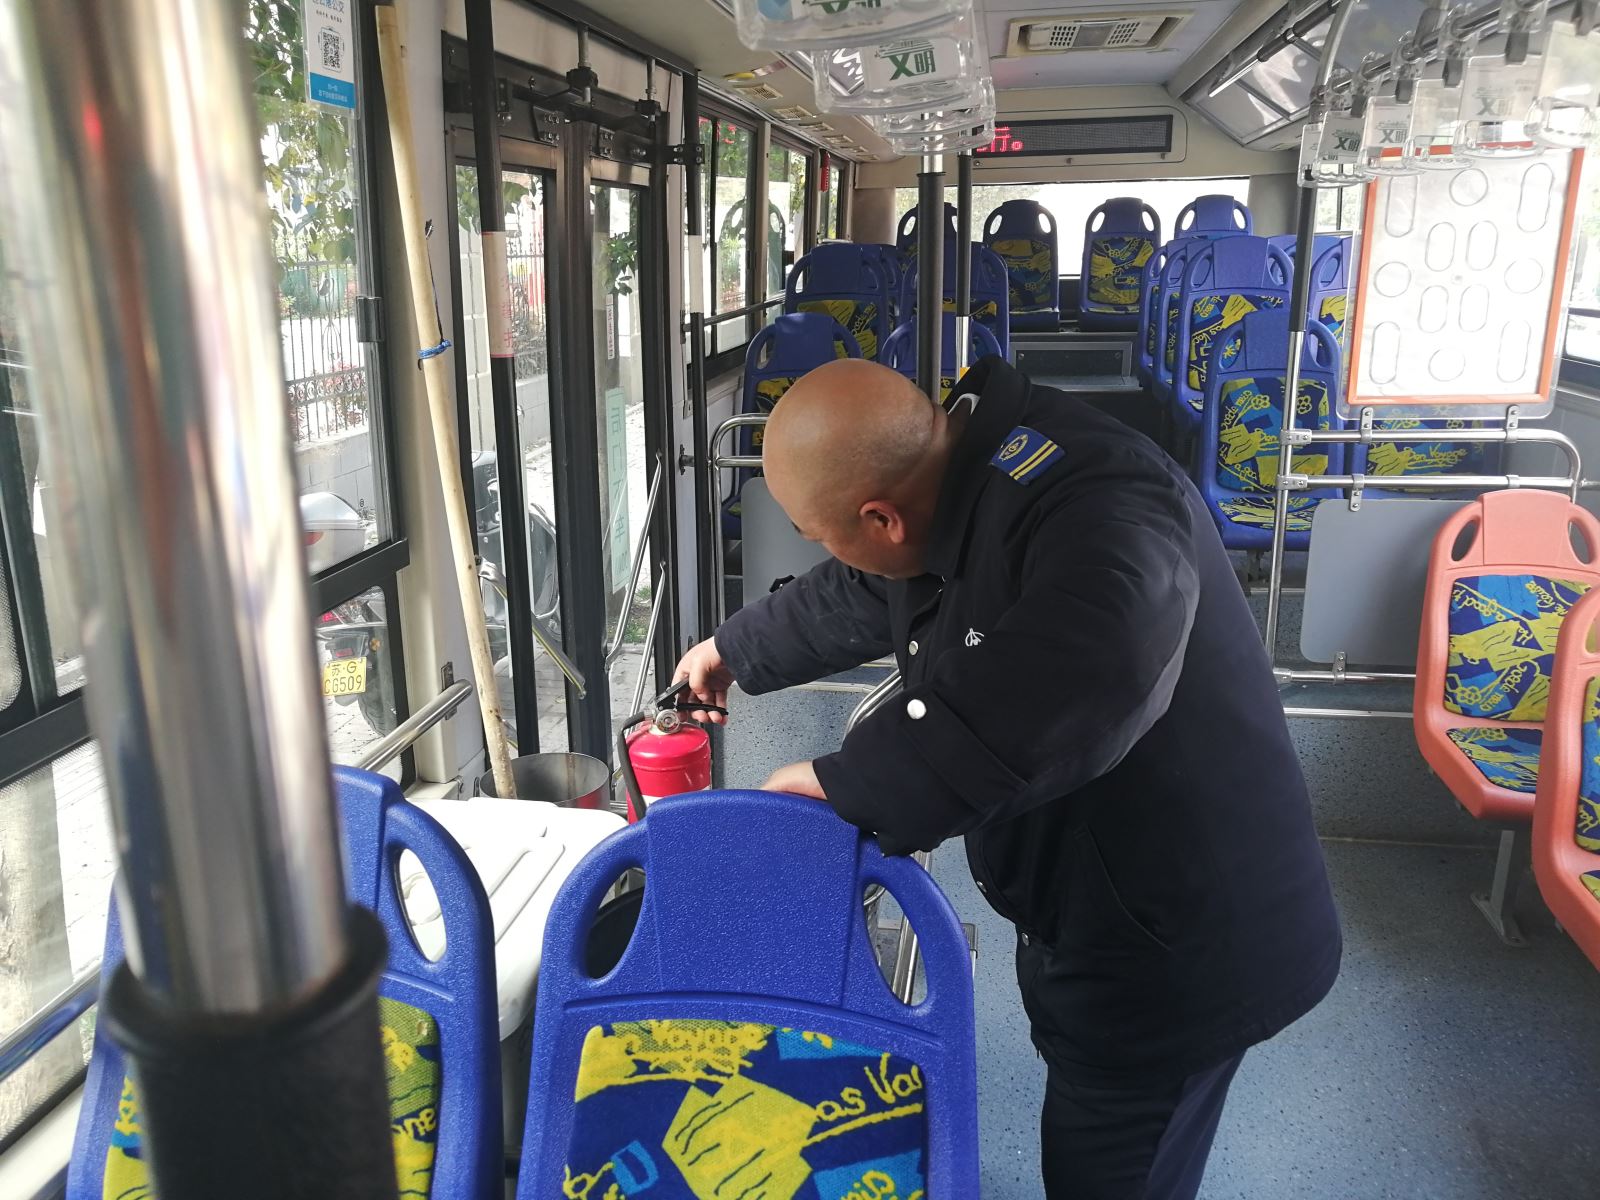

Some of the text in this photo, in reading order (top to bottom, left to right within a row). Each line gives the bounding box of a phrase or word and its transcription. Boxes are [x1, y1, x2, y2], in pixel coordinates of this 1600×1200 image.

[880, 46, 937, 81] 文明
[1333, 133, 1361, 152] 文明
[324, 674, 363, 694] CG509
